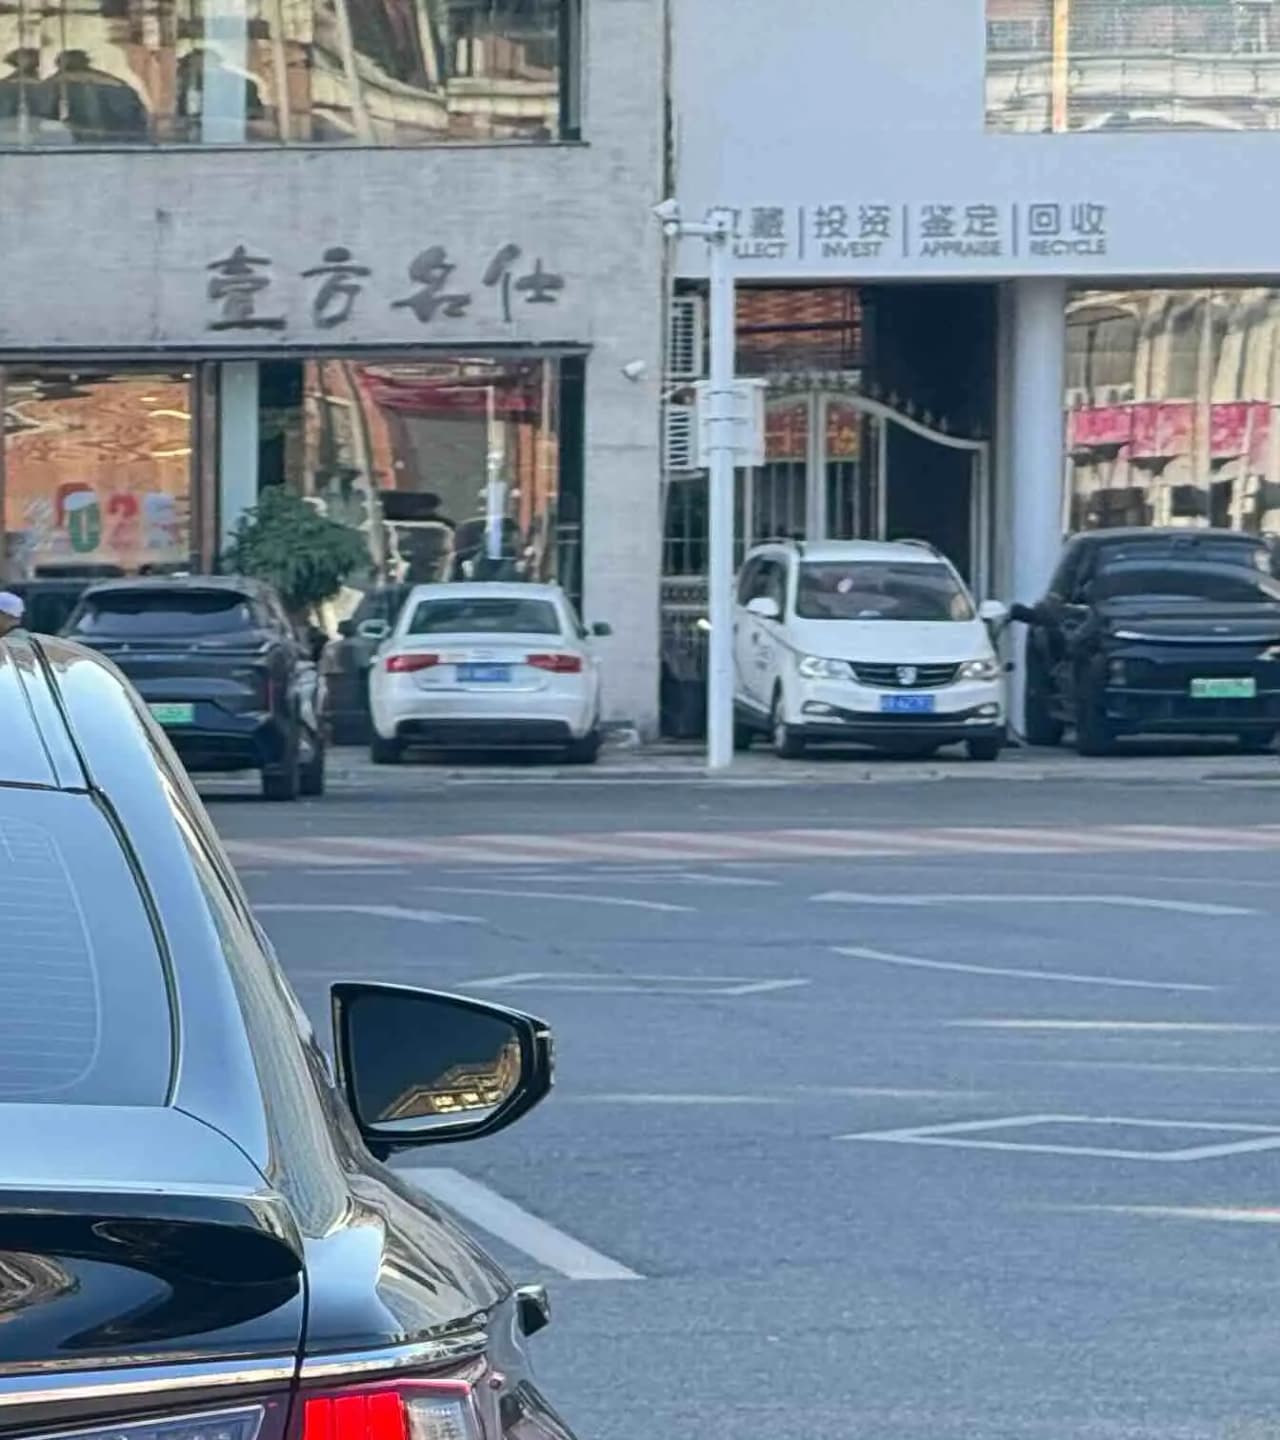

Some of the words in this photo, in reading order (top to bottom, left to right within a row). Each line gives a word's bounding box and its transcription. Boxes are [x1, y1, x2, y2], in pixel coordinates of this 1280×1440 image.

[814, 205, 890, 238] 投资
[1029, 203, 1106, 236] 回收
[822, 241, 883, 257] INVEST
[1030, 240, 1106, 255] RECYCLE
